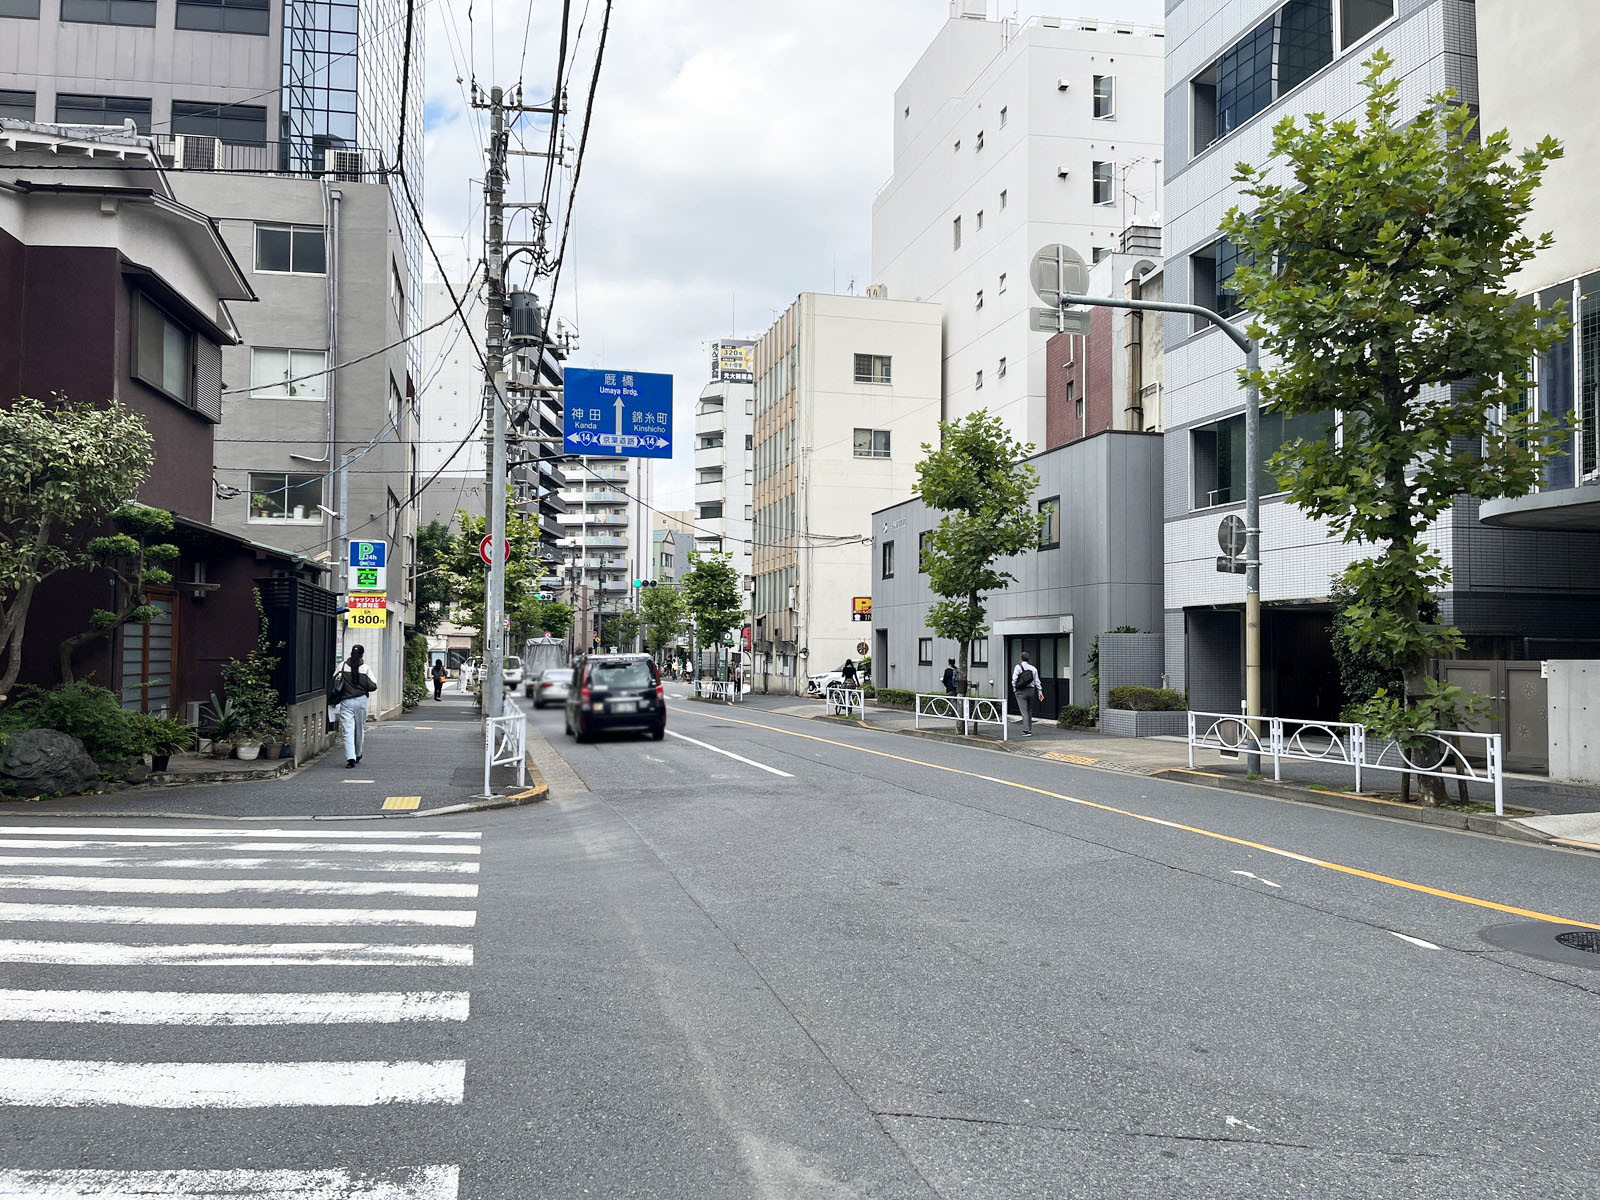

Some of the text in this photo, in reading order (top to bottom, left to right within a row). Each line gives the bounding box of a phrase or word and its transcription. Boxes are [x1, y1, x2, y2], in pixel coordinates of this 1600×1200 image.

[604, 373, 634, 387] 厩橋
[600, 386, 639, 397] Umaya Brdg.
[571, 407, 601, 420] 神田
[632, 411, 668, 425] 錦糸町
[633, 424, 666, 433] Kinshicho
[581, 433, 590, 441] 14
[602, 436, 635, 445] 京葉道路
[359, 542, 374, 561] P
[357, 568, 378, 587] 空
